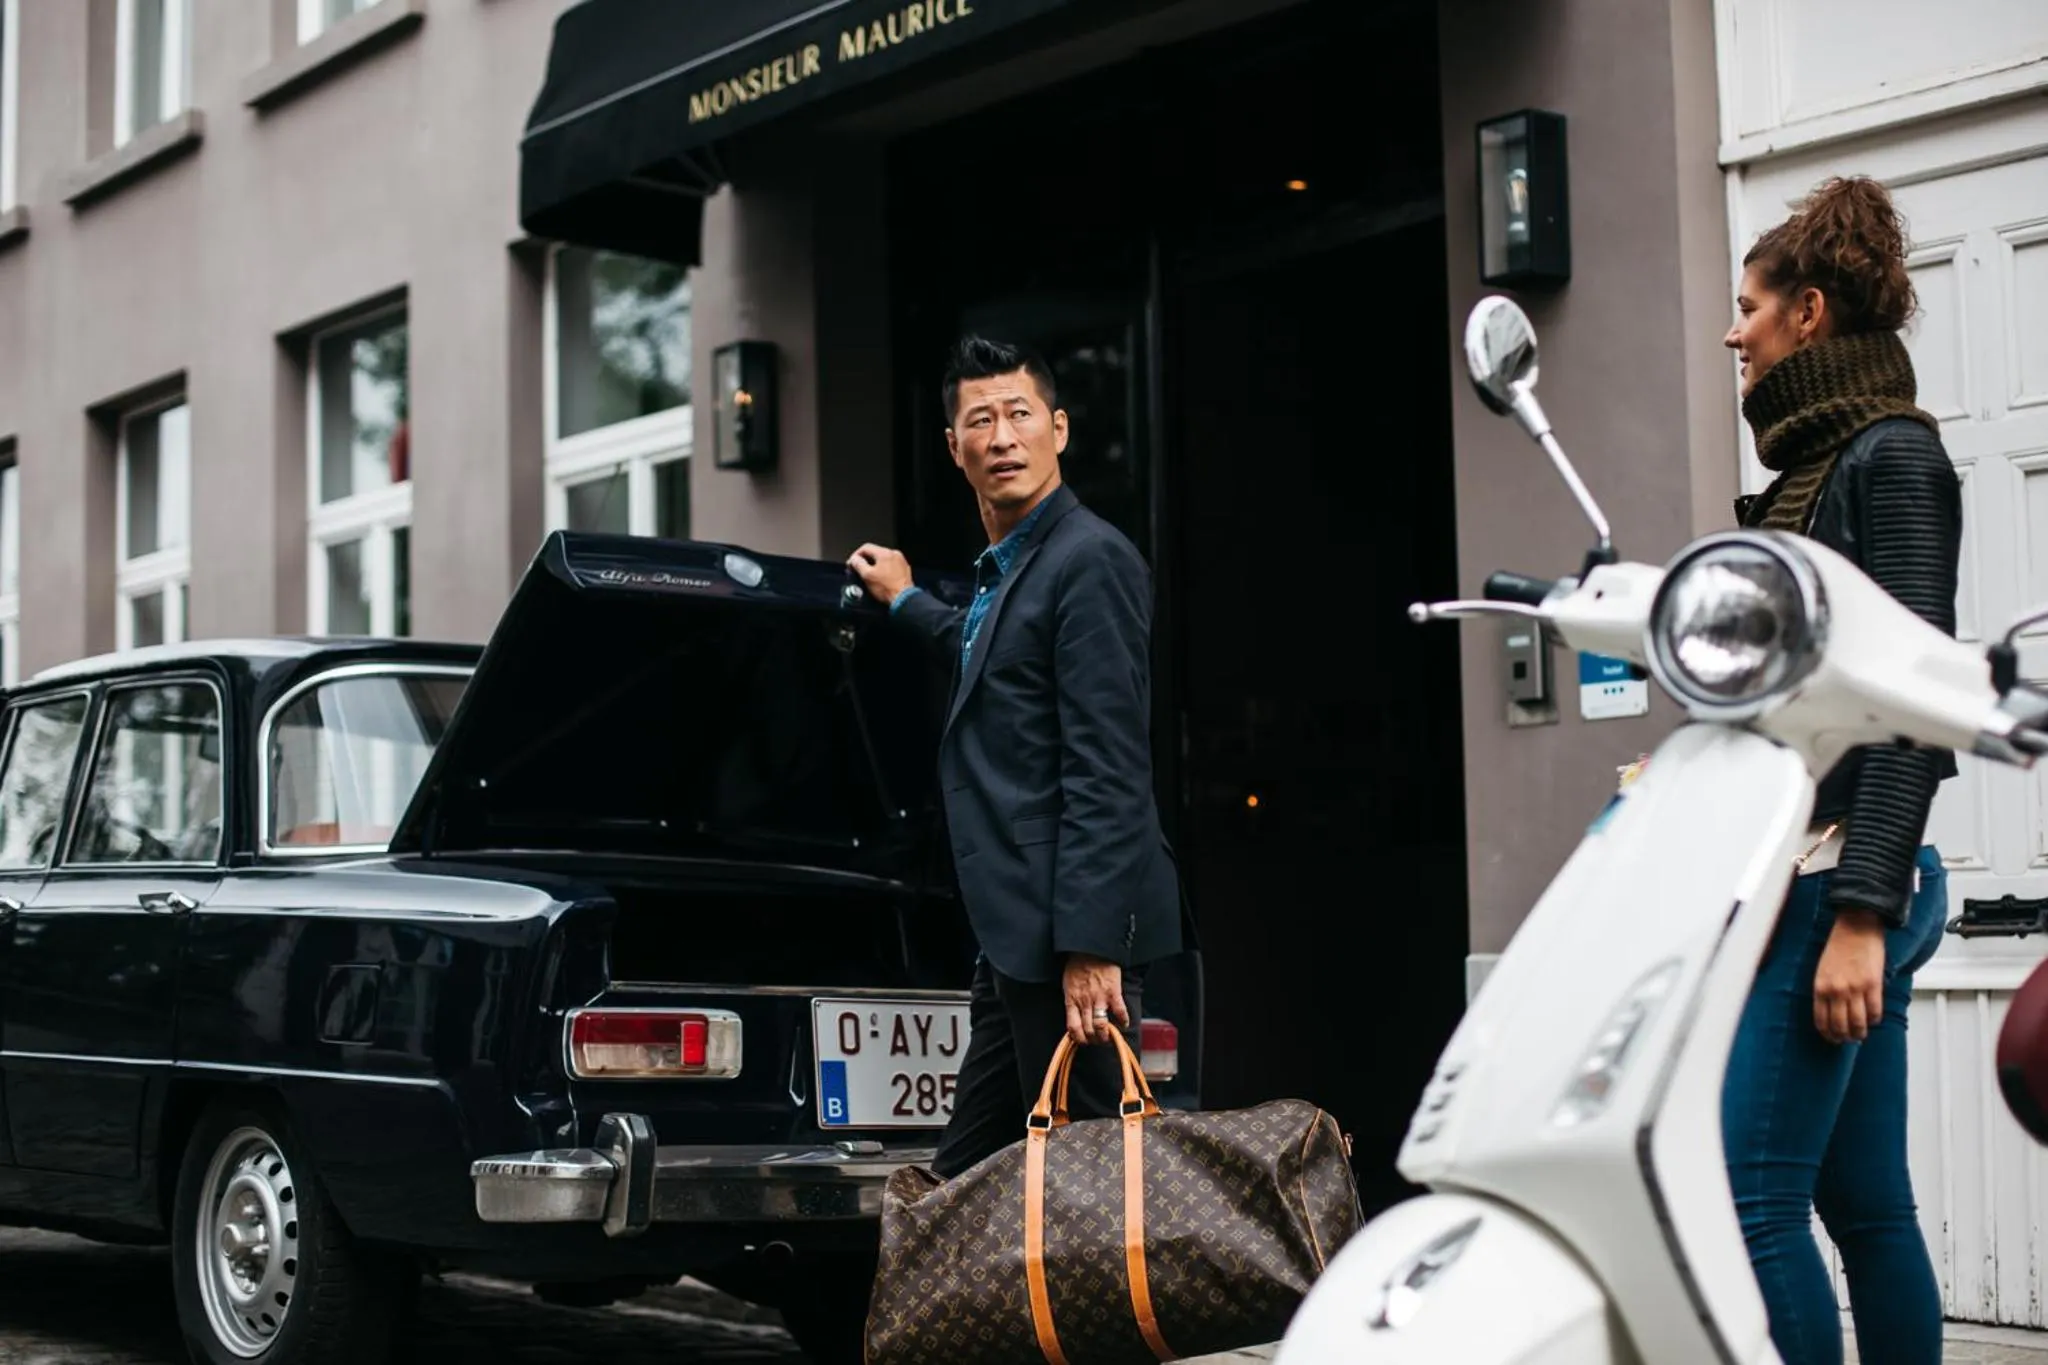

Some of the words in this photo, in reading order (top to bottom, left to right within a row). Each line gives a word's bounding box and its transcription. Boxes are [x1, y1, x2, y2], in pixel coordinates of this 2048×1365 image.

[688, 43, 821, 125] MONSIEUR
[651, 571, 712, 587] Romeo
[827, 1097, 843, 1118] B
[890, 1072, 960, 1117] 285
